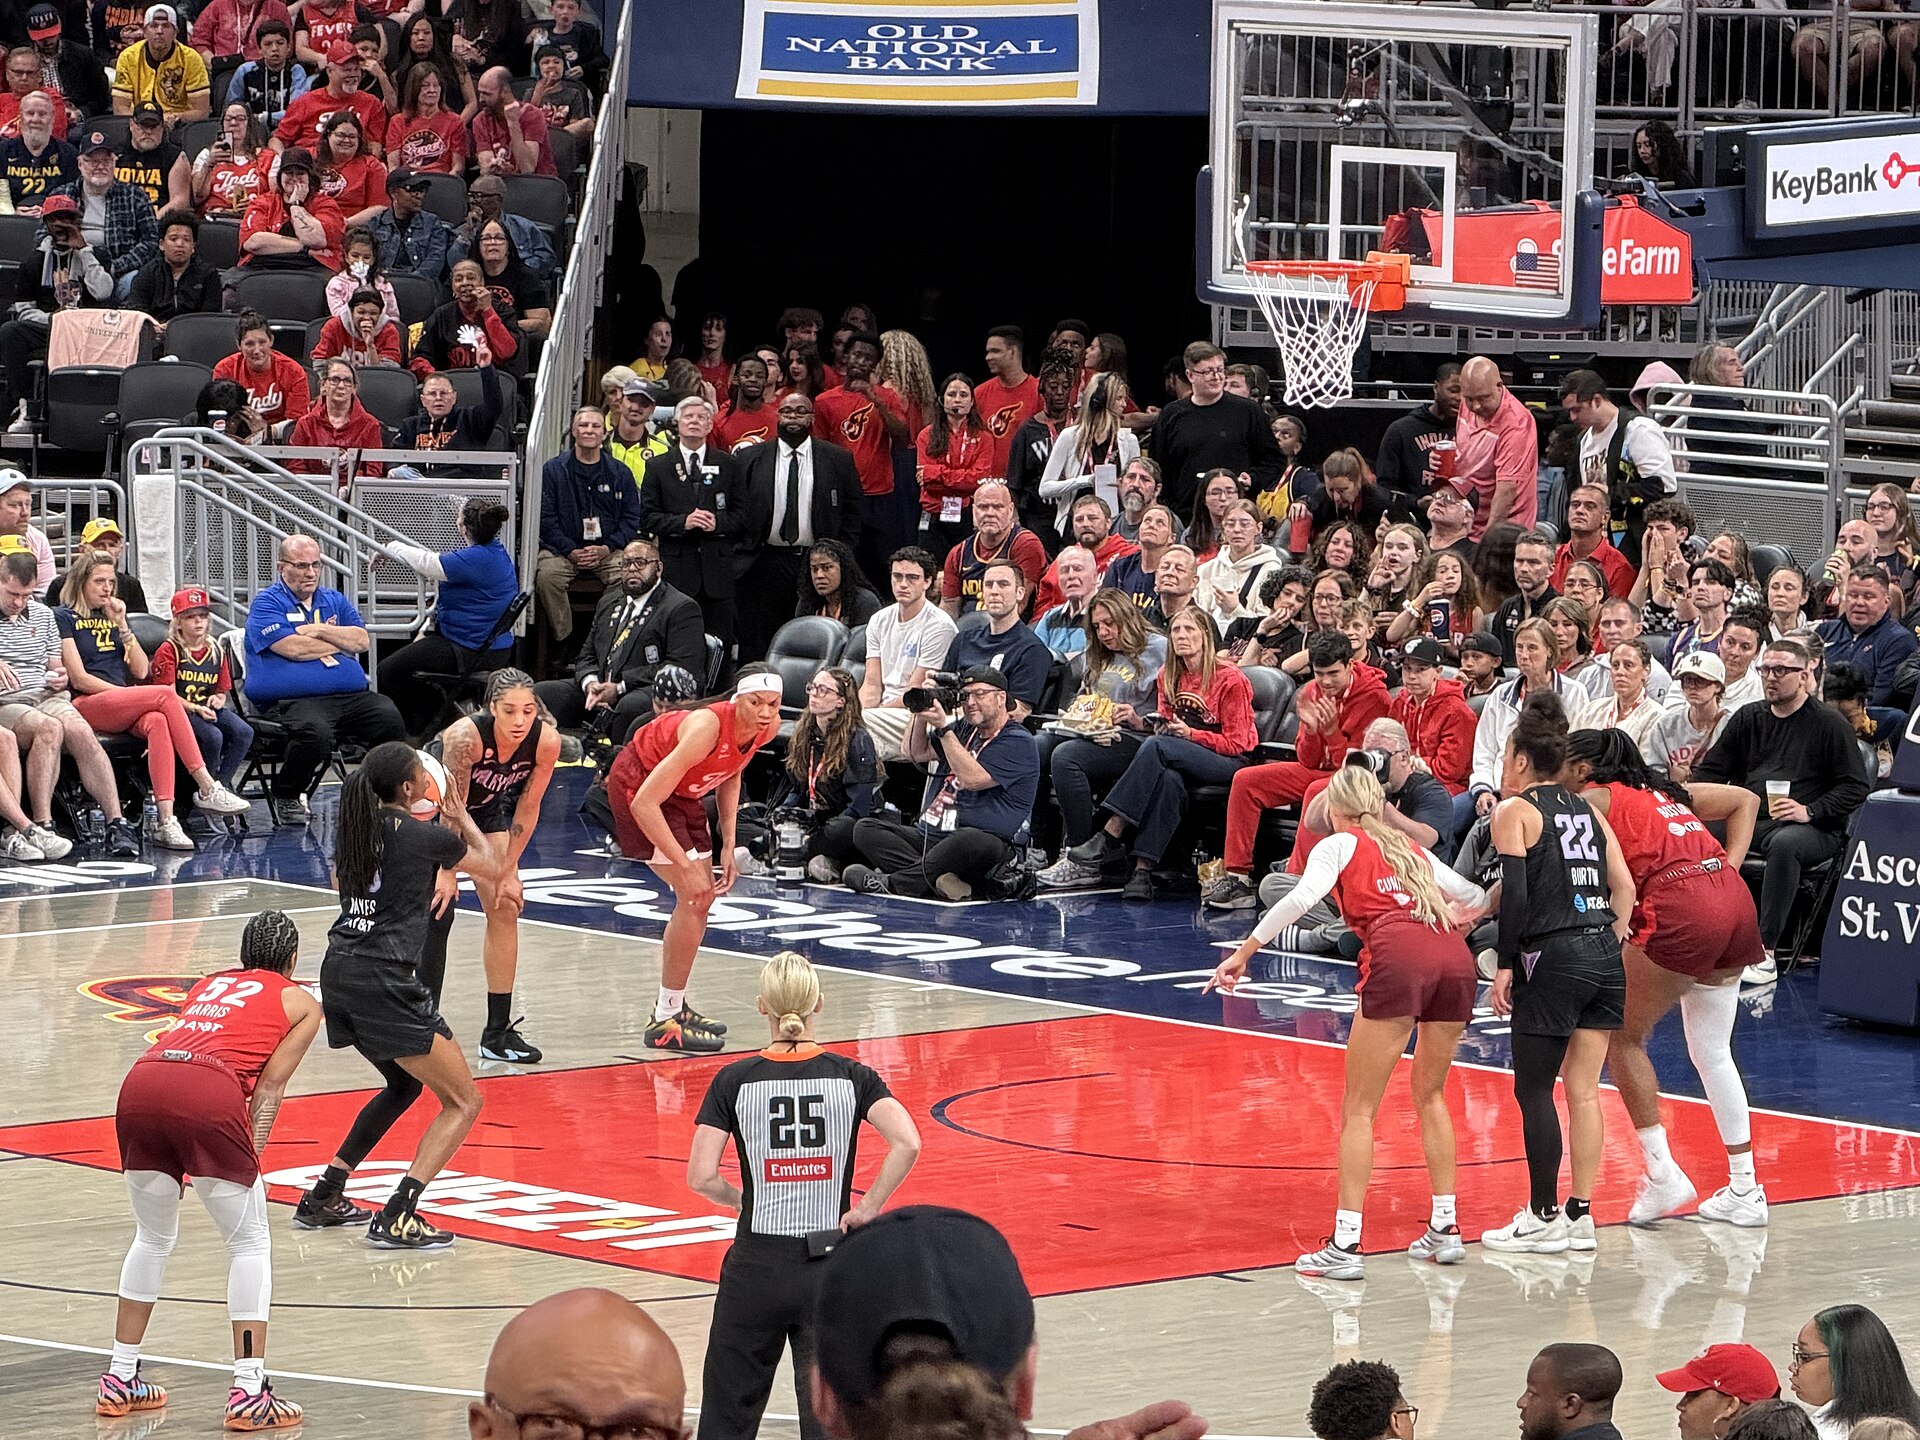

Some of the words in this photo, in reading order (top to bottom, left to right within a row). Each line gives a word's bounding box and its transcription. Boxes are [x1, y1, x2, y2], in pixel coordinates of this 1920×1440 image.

[867, 24, 979, 40] OLD
[785, 36, 1058, 56] NATIONAL
[846, 56, 998, 71] BANK
[7, 165, 62, 178] INDIANA
[1772, 164, 1879, 204] KeyBank
[246, 382, 283, 413] Indy
[91, 628, 115, 647] 22
[177, 670, 219, 684] NDIANA
[1554, 813, 1600, 861] 22
[1843, 840, 1920, 887] Asc
[1840, 896, 1889, 942] St.
[196, 976, 264, 1008] 52
[184, 1003, 231, 1018] HARRIS
[184, 1020, 224, 1033] AT&T
[769, 1094, 826, 1149] 25
[770, 1162, 827, 1177] Emirates
